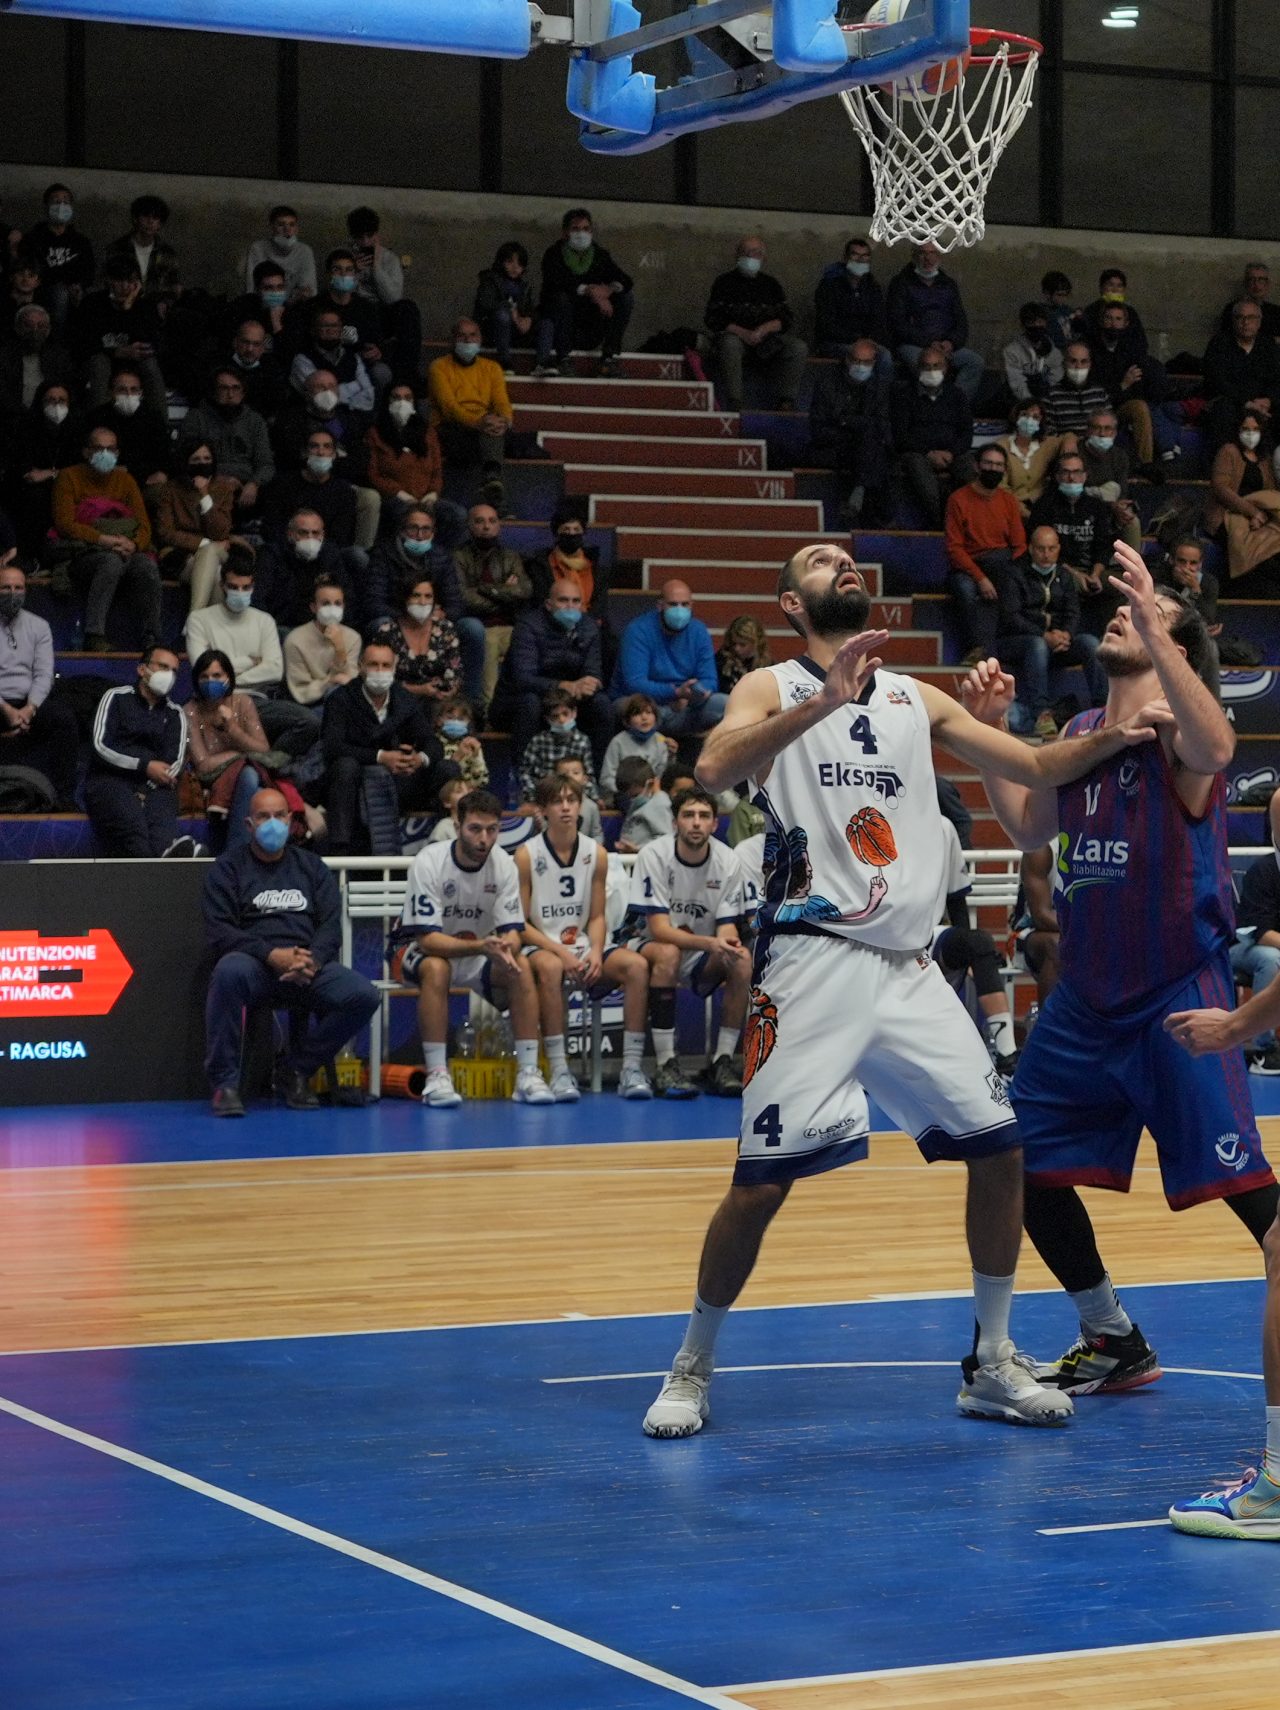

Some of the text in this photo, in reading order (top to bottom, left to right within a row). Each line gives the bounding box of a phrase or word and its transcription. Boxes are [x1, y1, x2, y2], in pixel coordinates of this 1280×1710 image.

[882, 605, 902, 625] VI
[849, 714, 878, 755] 4
[1072, 833, 1129, 864] Lars
[1073, 864, 1127, 877] Riabilitazione
[560, 875, 576, 897] 3
[411, 894, 435, 918] 15
[0, 985, 73, 1001] TIMARCA
[10, 1041, 87, 1060] RAGUSA
[753, 1103, 783, 1147] 4
